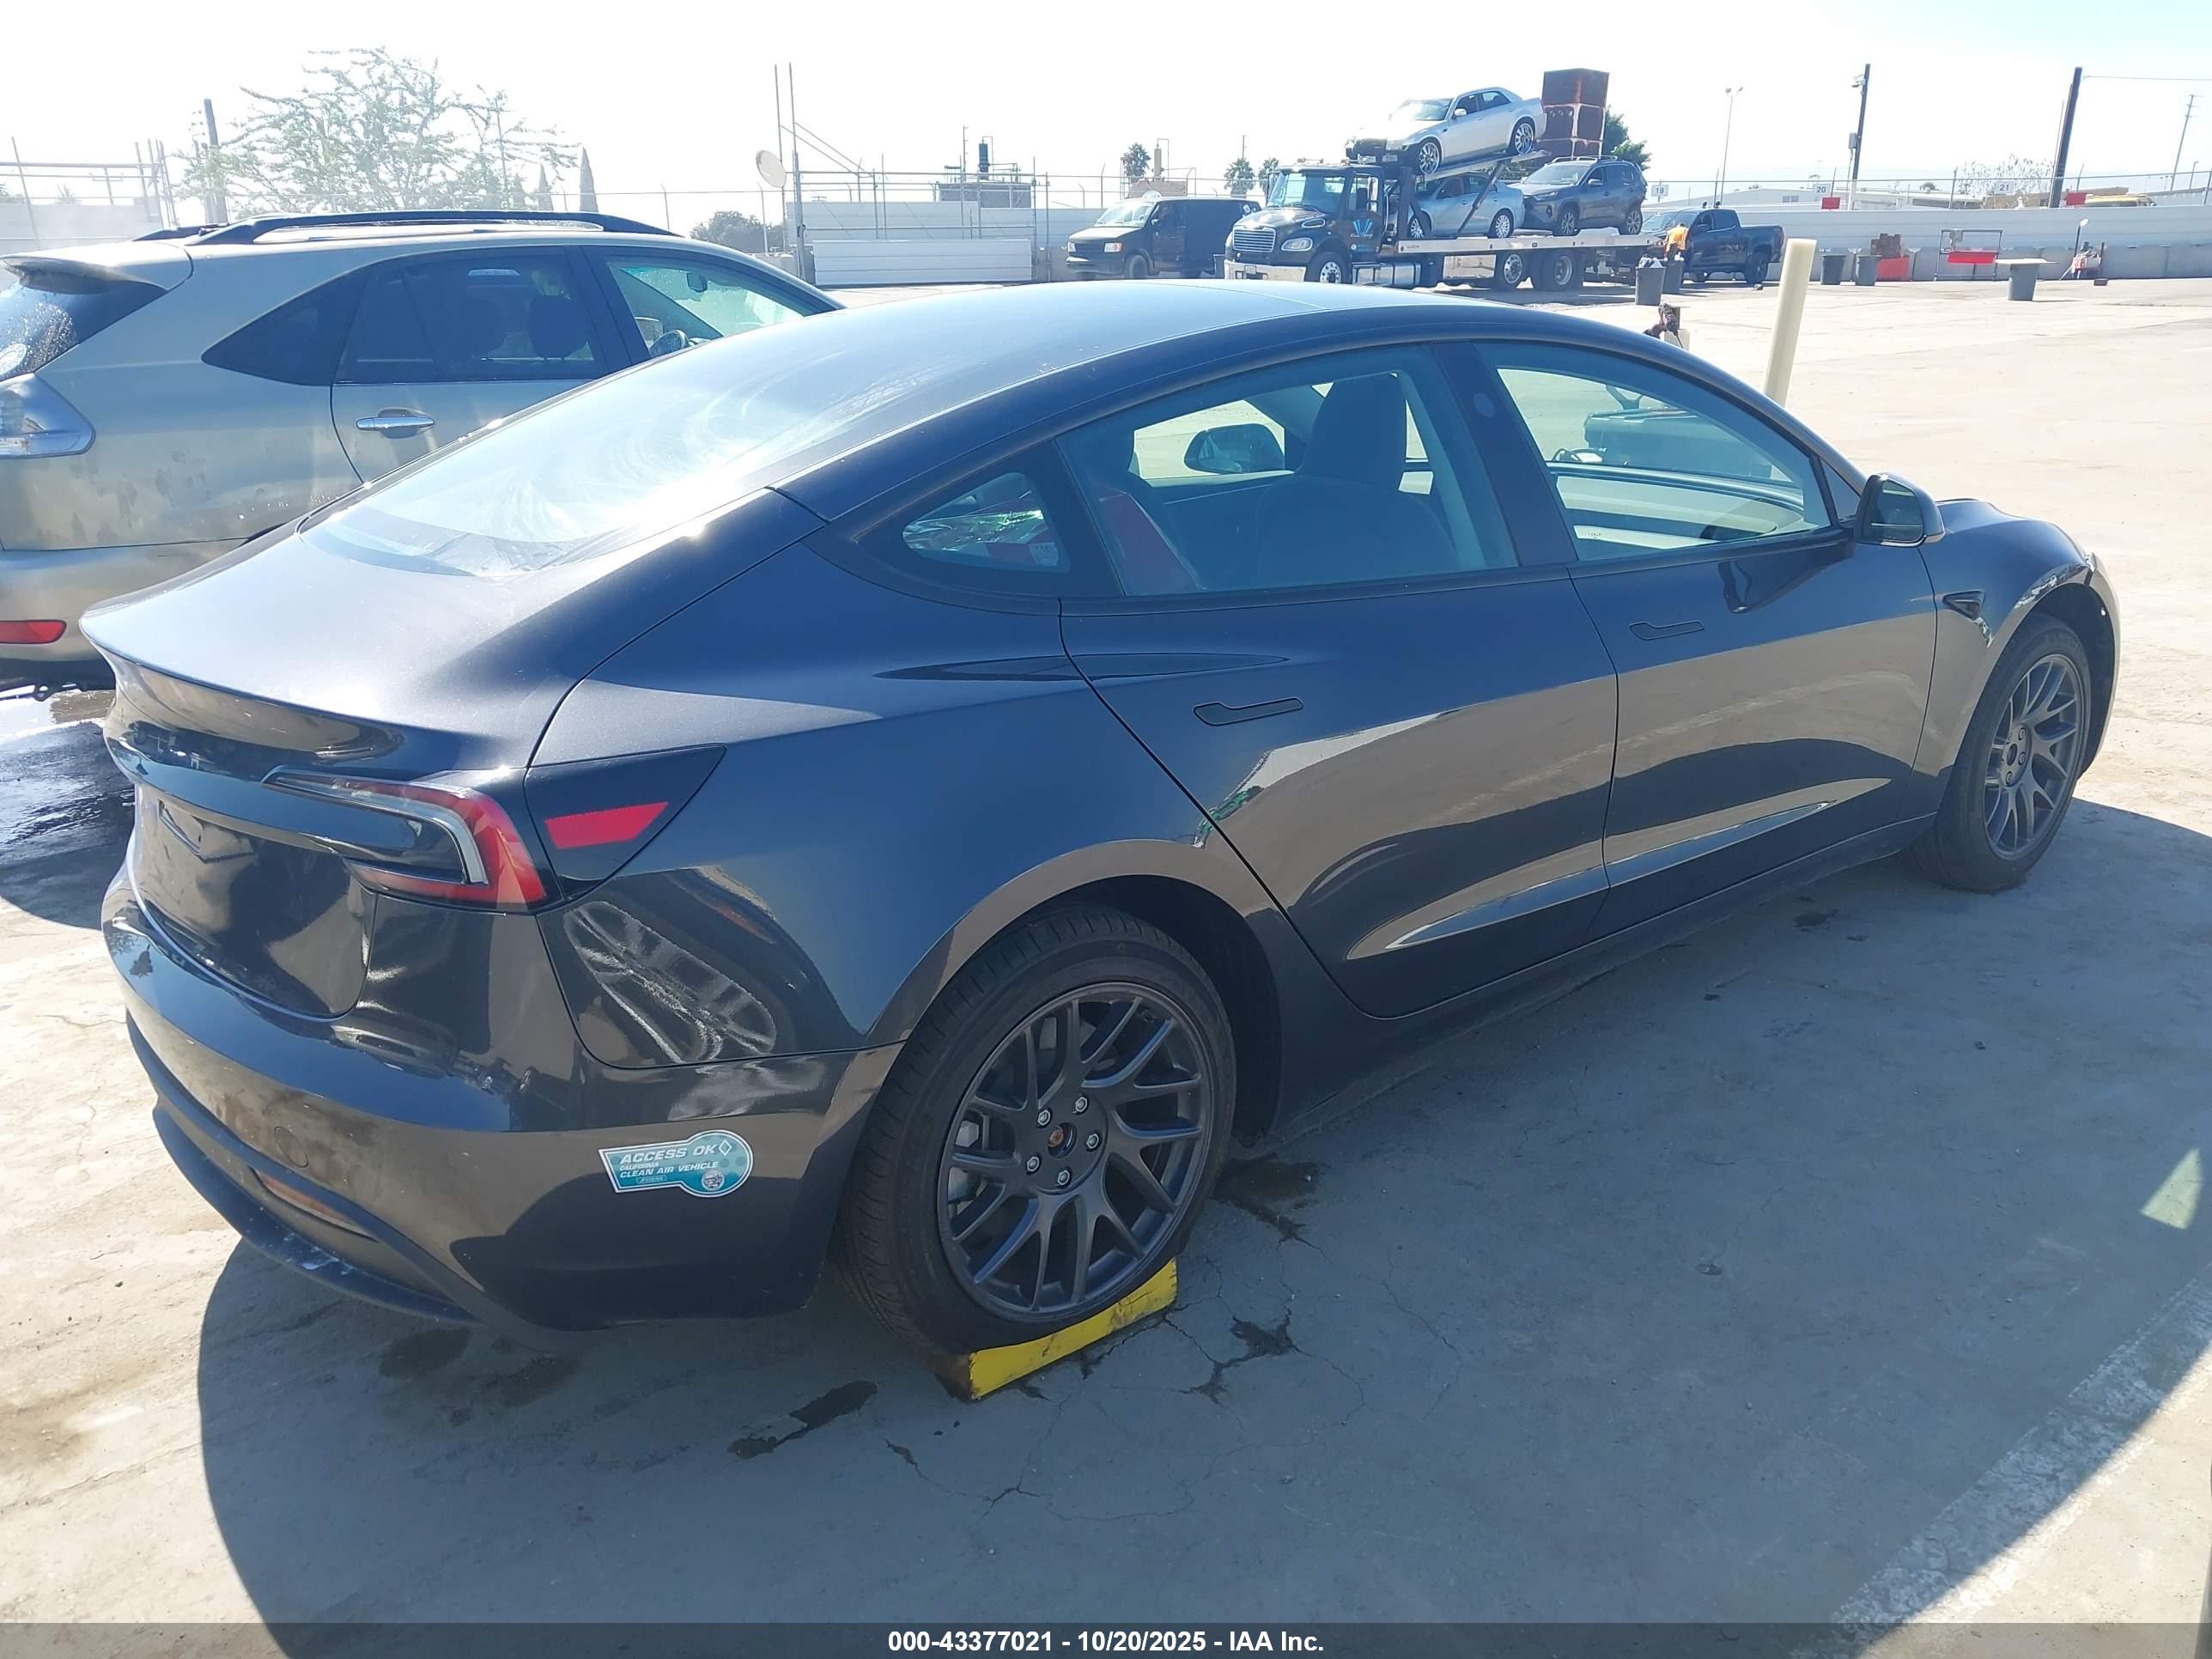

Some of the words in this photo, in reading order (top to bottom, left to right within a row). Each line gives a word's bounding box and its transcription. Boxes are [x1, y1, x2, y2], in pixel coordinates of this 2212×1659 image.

[620, 1148, 687, 1164] ACCESS
[692, 1144, 716, 1156] OK
[620, 1169, 653, 1179] CLEAN
[656, 1166, 674, 1175] AIR
[678, 1161, 720, 1173] VEHICLE
